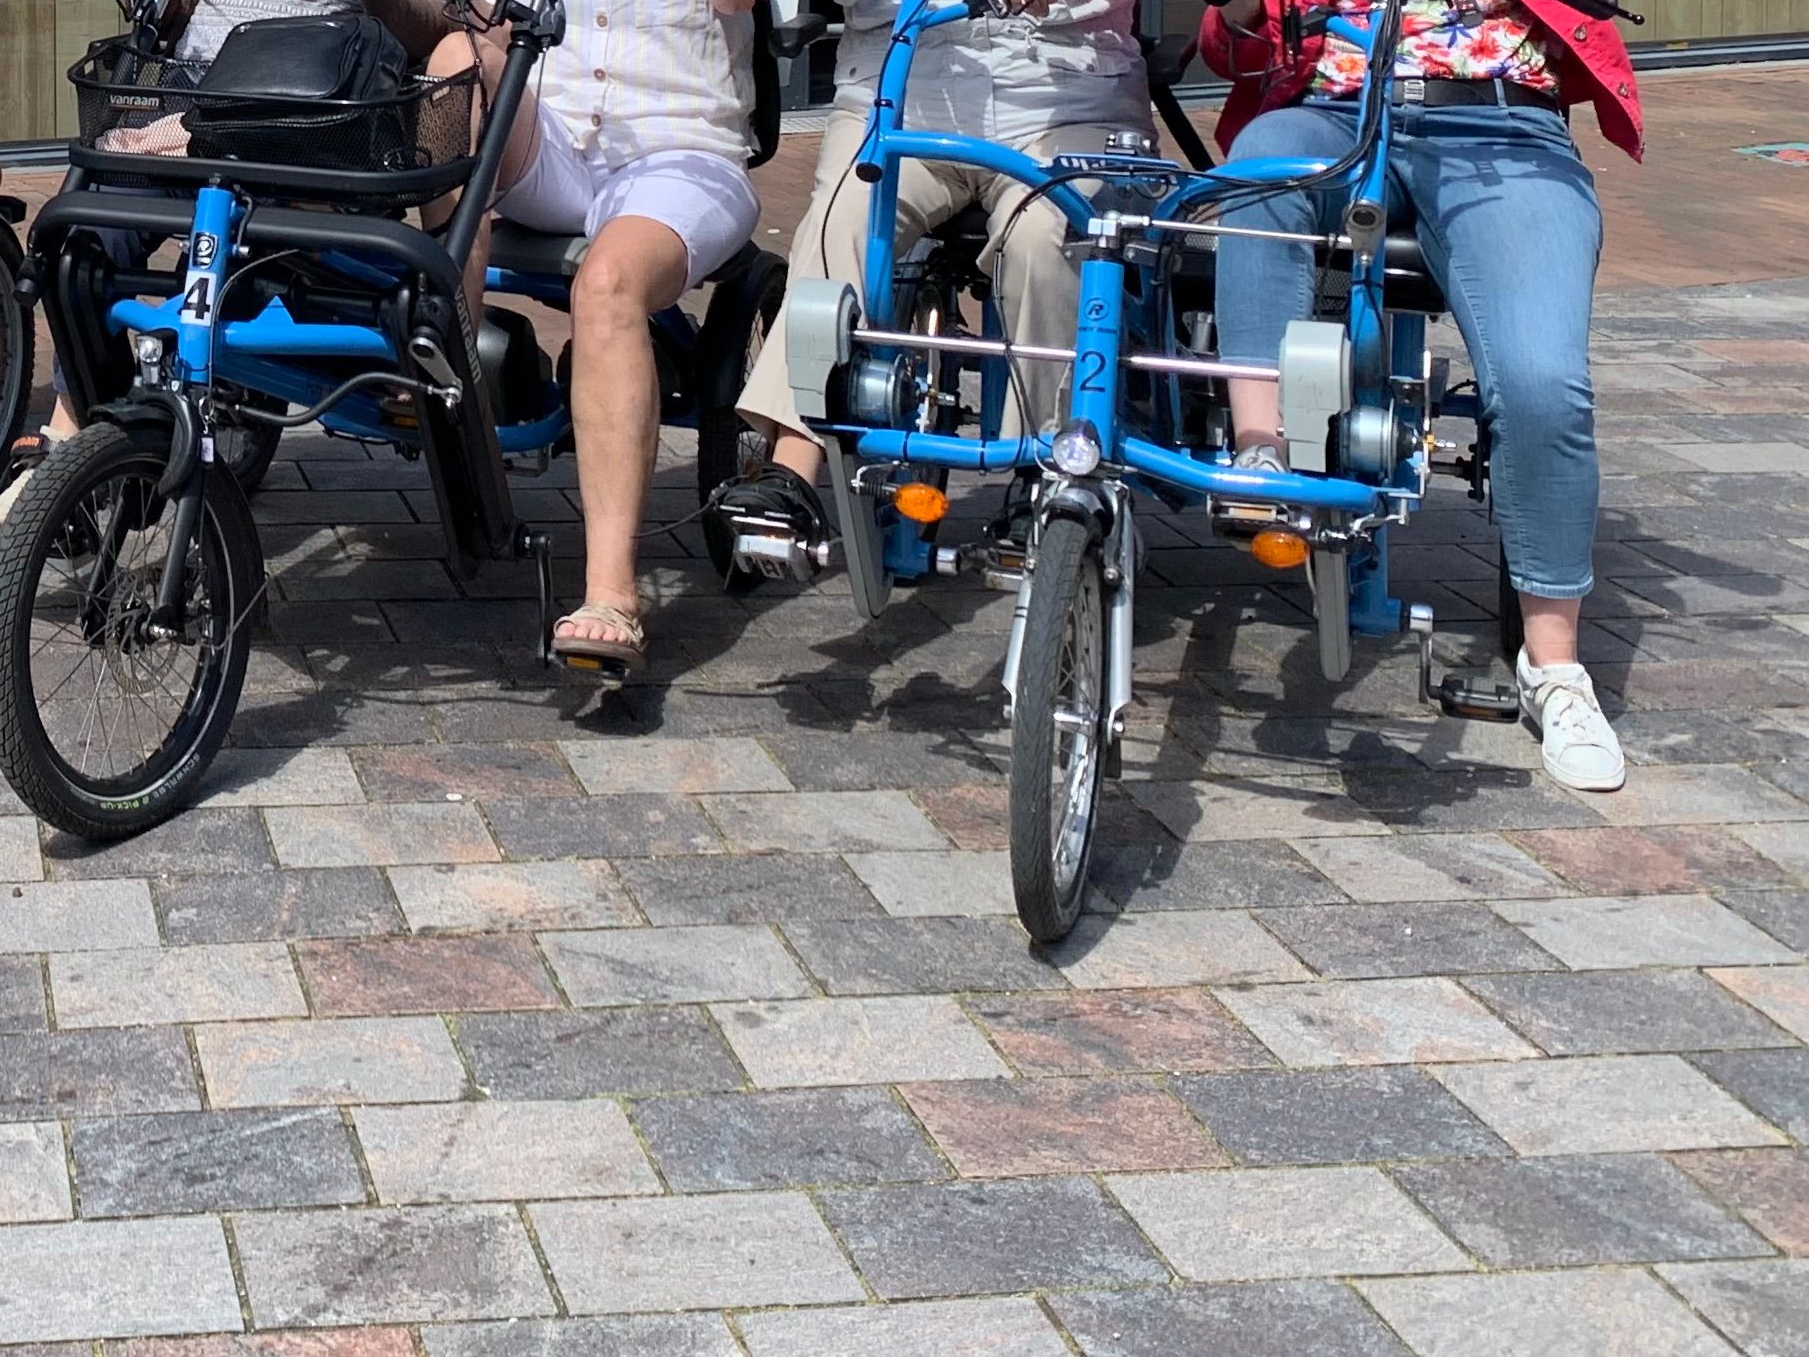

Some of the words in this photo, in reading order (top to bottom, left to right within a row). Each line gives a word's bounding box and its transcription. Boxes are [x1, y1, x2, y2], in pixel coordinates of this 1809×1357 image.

[109, 94, 160, 107] vanraam
[178, 276, 212, 320] 4
[454, 284, 482, 384] vanraam
[1079, 350, 1107, 393] 2
